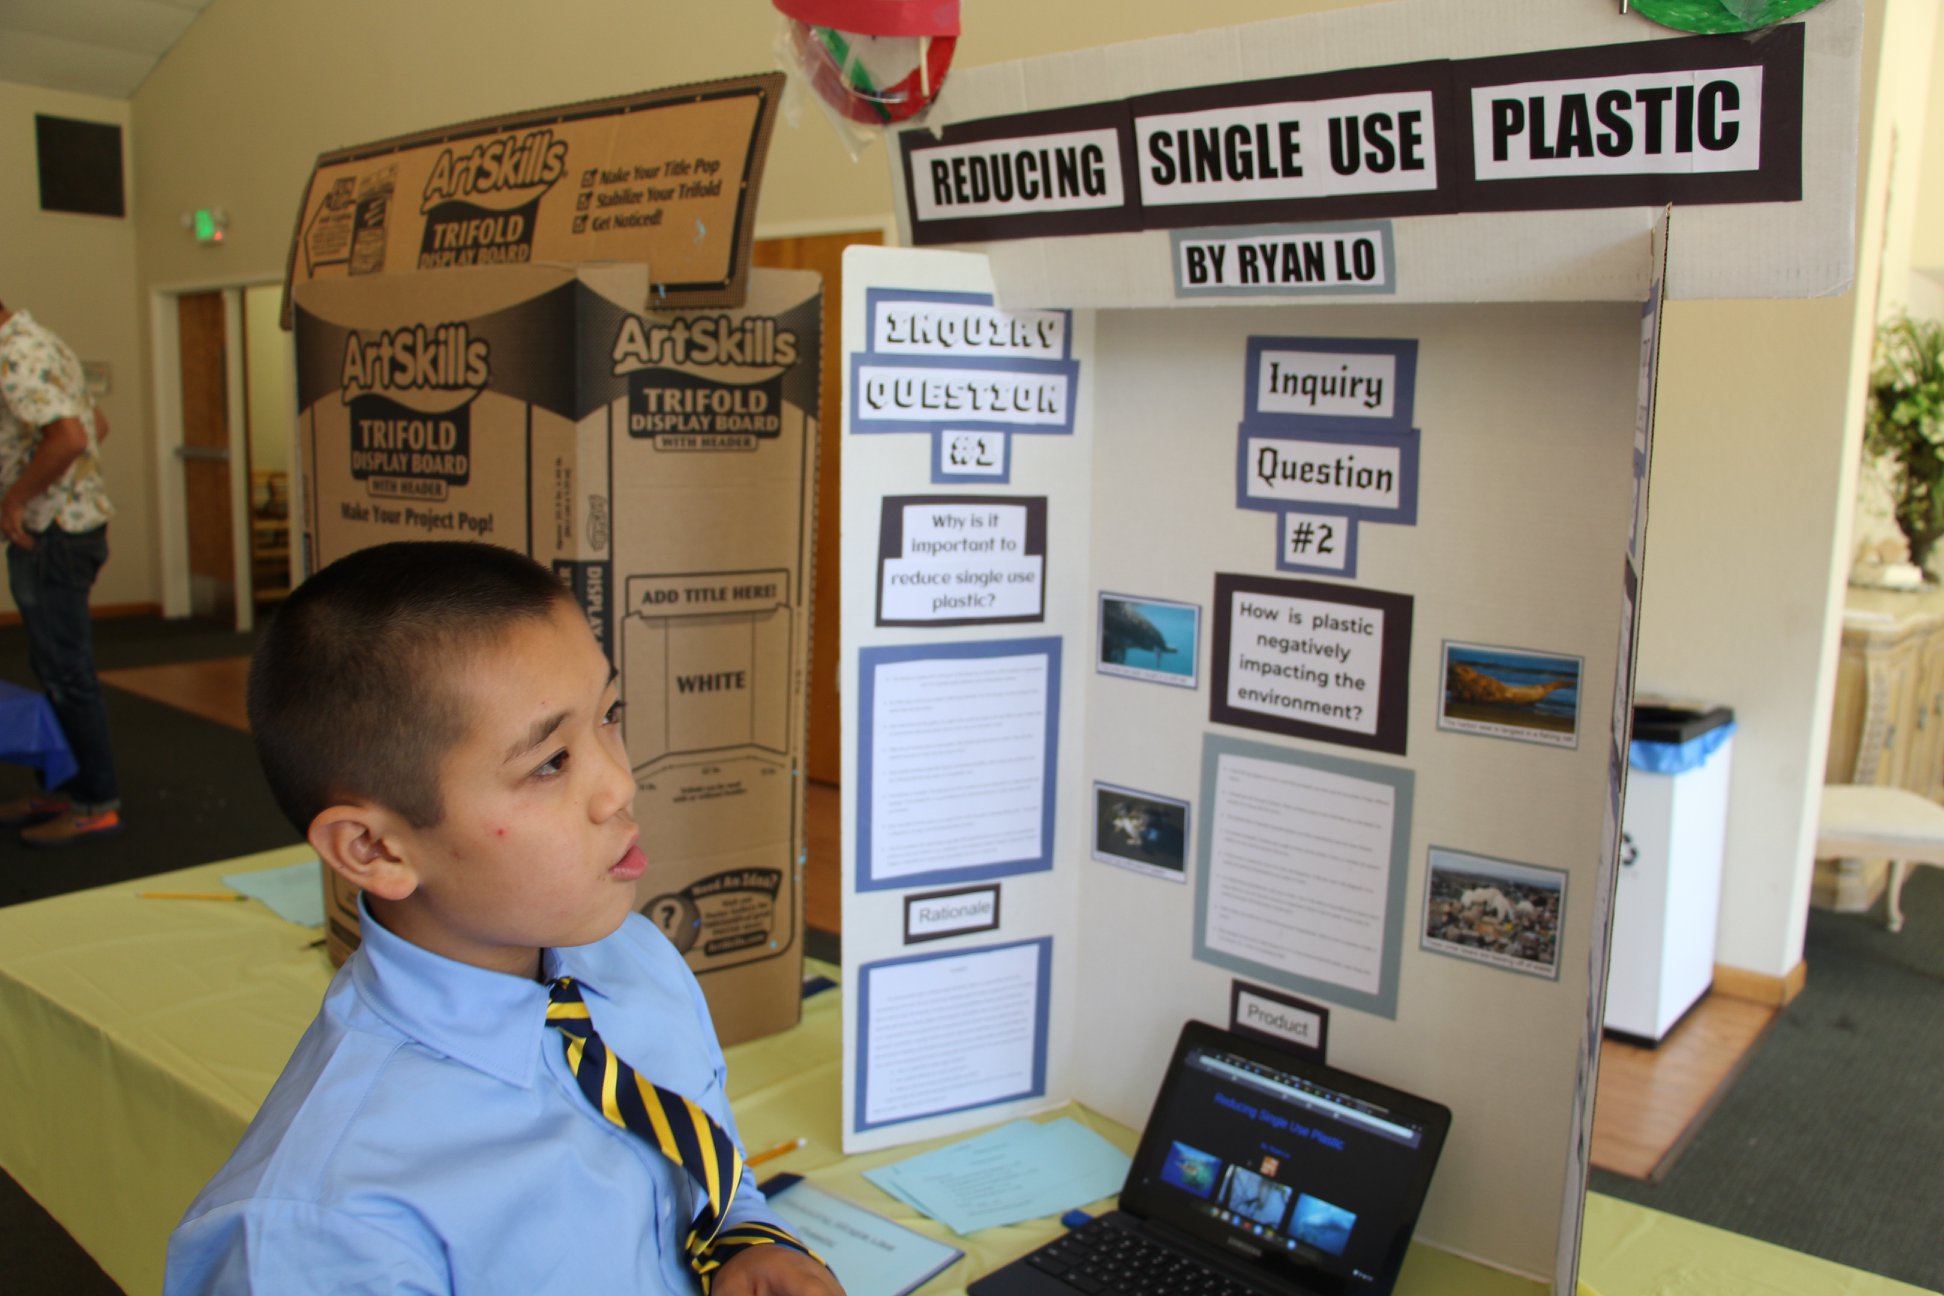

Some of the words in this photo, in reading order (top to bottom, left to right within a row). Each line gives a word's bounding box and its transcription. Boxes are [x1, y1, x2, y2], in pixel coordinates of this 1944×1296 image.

[930, 144, 1107, 206] REDUCING
[1148, 120, 1304, 187] SINGLE
[1327, 110, 1425, 176] USE
[1491, 79, 1741, 162] PLASTIC
[422, 128, 568, 200] ArtSkills
[599, 167, 630, 185] Make
[634, 165, 661, 180] Your
[664, 159, 691, 177] Title
[694, 157, 720, 175] Pop
[597, 187, 643, 208] Stabilize
[647, 186, 674, 201] Your
[679, 179, 722, 199] Trifold
[433, 214, 525, 249] TRIFOLD
[592, 216, 611, 231] Get
[613, 209, 663, 228] Noticed!
[478, 243, 530, 264] BOARD
[1186, 244, 1226, 284] BY
[1238, 240, 1325, 283] RYAN
[1335, 238, 1376, 282] LO
[613, 314, 798, 366] ArtSkills
[341, 322, 490, 389] ArtSkills
[866, 377, 1057, 414] QUESTION
[1269, 362, 1384, 409] Inquiry
[642, 388, 768, 414] TRIFOLD
[359, 419, 457, 451] TRIFOLD
[631, 414, 712, 432] DISPLAY
[715, 415, 779, 432] BOARD
[662, 436, 696, 447] WITH
[700, 435, 751, 448] HEADER
[352, 451, 409, 473] DISPLAY
[412, 453, 468, 475] BOARD
[1256, 446, 1394, 494] Question
[372, 480, 397, 493] WITH
[400, 481, 442, 496] HEADER
[341, 502, 369, 522] Make
[373, 505, 401, 524] Your
[404, 507, 454, 532] Project
[458, 512, 494, 535] Pop!
[932, 513, 965, 531] Why
[970, 513, 983, 528] is
[988, 513, 999, 528] it
[911, 538, 995, 556] important
[1001, 537, 1017, 551] to
[1291, 522, 1335, 555] #2
[891, 570, 951, 585] reduce
[955, 568, 1003, 588] single
[1007, 570, 1035, 583] use
[642, 589, 679, 604] ADD
[684, 586, 728, 603] TITLE
[732, 584, 777, 600] HERE!
[932, 593, 996, 612] plastic?
[1240, 601, 1279, 621] How
[1288, 607, 1302, 625] is
[1312, 613, 1374, 636] plastic
[1256, 634, 1351, 664] negatively
[676, 670, 746, 694] WHITE
[1239, 654, 1329, 688] impacting
[1334, 672, 1366, 691] the
[1237, 687, 1363, 721] environment?
[723, 875, 740, 889] An
[918, 900, 993, 923] Rationale
[1247, 1003, 1310, 1037] Product
